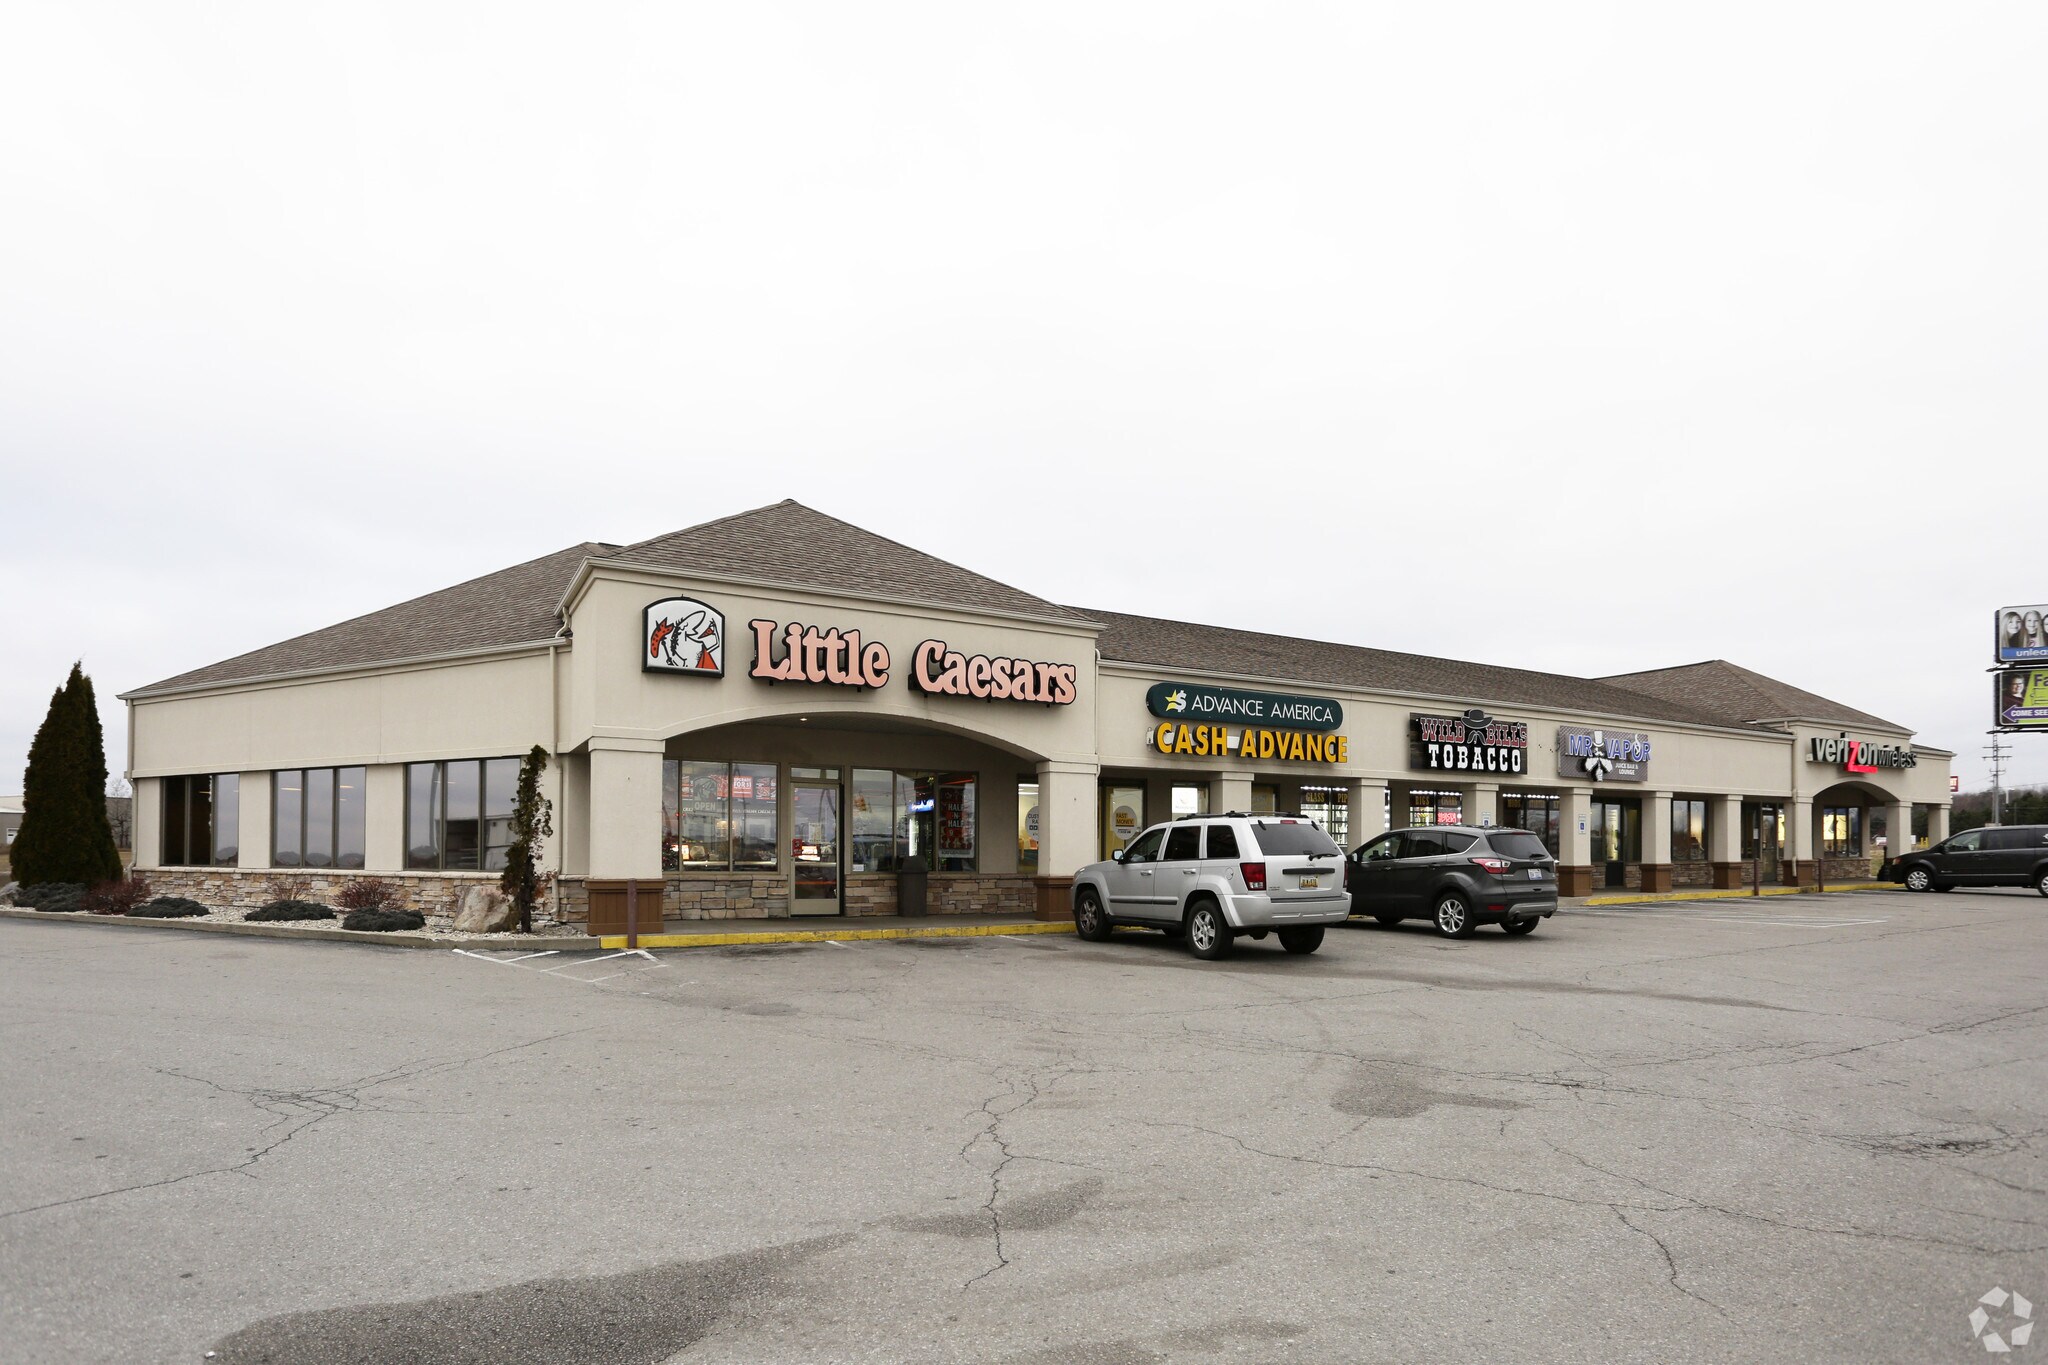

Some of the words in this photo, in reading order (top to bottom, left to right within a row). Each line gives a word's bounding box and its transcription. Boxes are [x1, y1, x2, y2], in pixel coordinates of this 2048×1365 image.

[749, 619, 890, 689] Little
[913, 638, 1076, 705] Caesars
[1191, 695, 1264, 717] ADVANCE
[1270, 703, 1334, 723] AMERICA
[1156, 722, 1228, 756] CASH
[1240, 728, 1348, 764] ADVANCE
[1420, 717, 1466, 744] WILD
[1485, 723, 1528, 748] BILL'S
[1428, 743, 1522, 772] TOBACCO
[1568, 733, 1593, 757] MR
[1605, 737, 1652, 762] VAPOR
[694, 801, 716, 811] OPEN
[948, 803, 965, 811] HALF
[1305, 792, 1325, 802] GLASS
[948, 819, 965, 828] HALF
